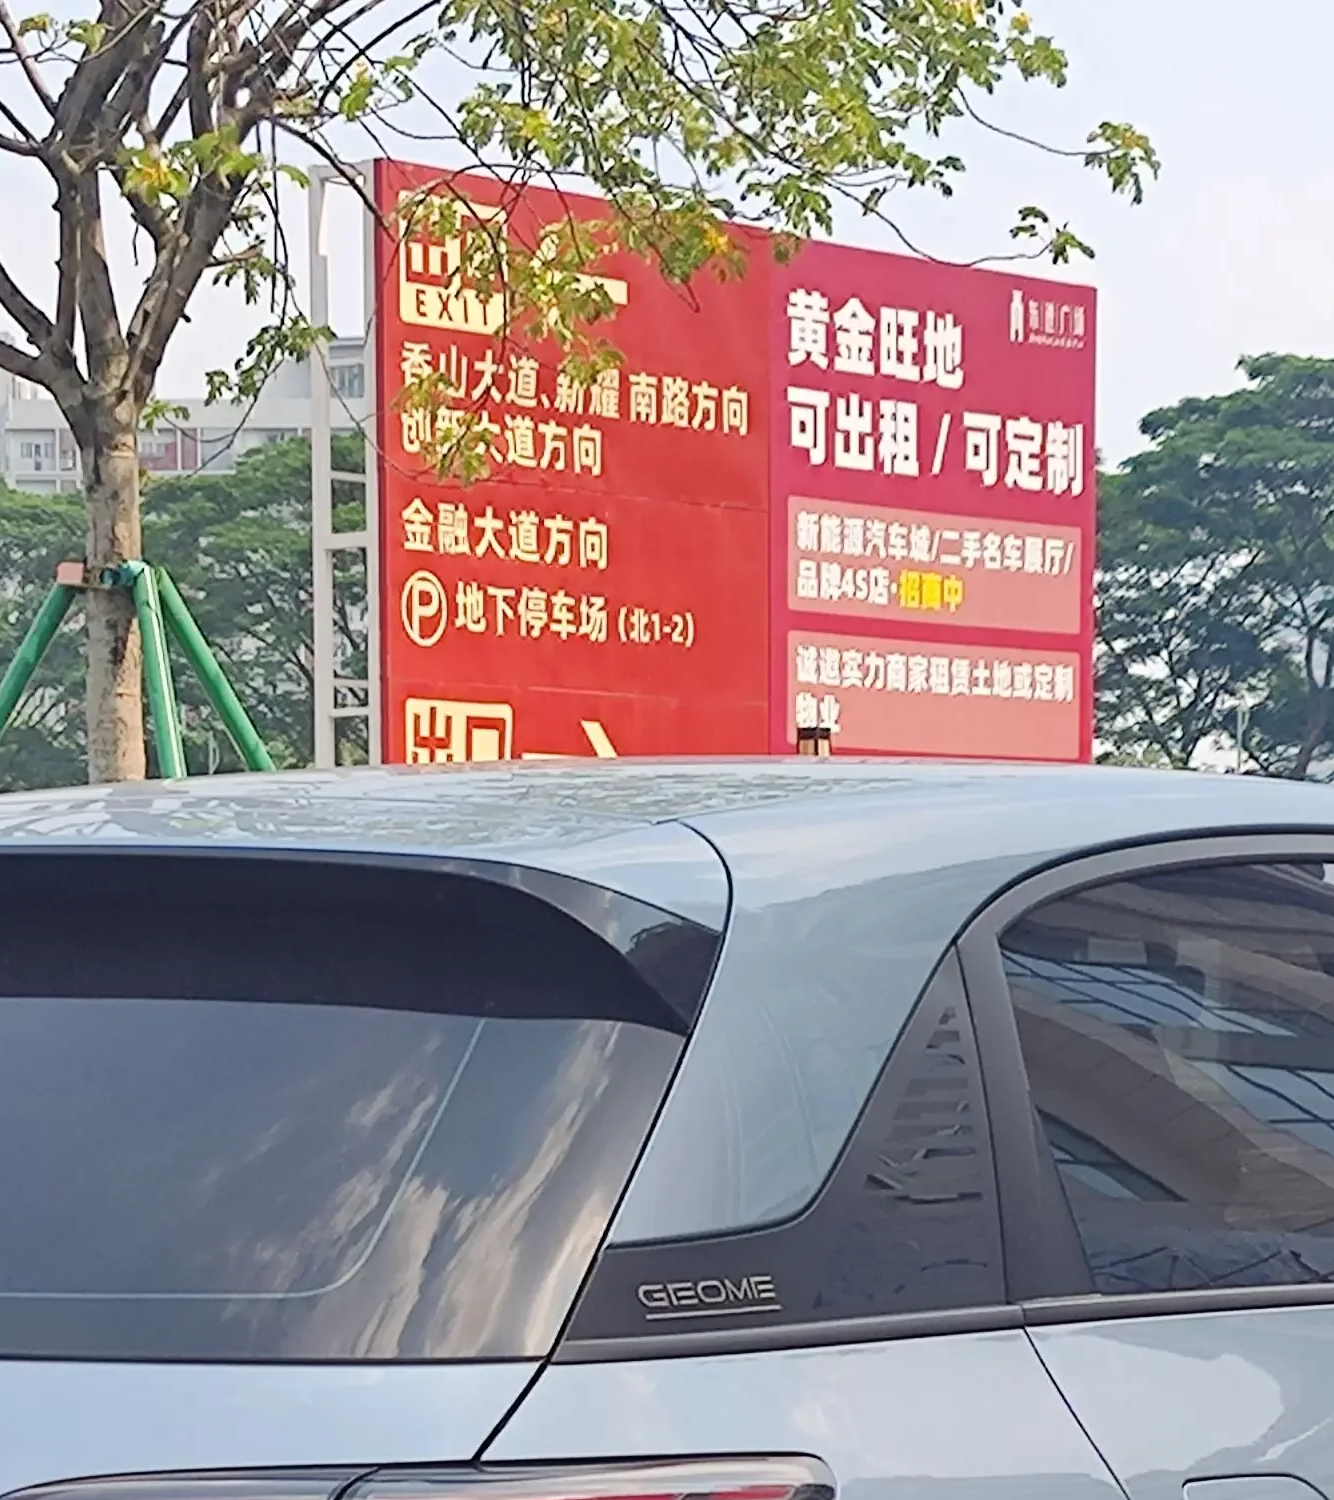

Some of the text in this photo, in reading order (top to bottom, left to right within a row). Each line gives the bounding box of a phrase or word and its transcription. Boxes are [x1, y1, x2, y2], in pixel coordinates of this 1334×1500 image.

[415, 288, 493, 326] EXIT
[787, 288, 964, 390] 黄金旺地
[401, 497, 608, 570] 金融大道方向
[455, 580, 609, 643] 地下停车场
[638, 1275, 776, 1308] GEOME
